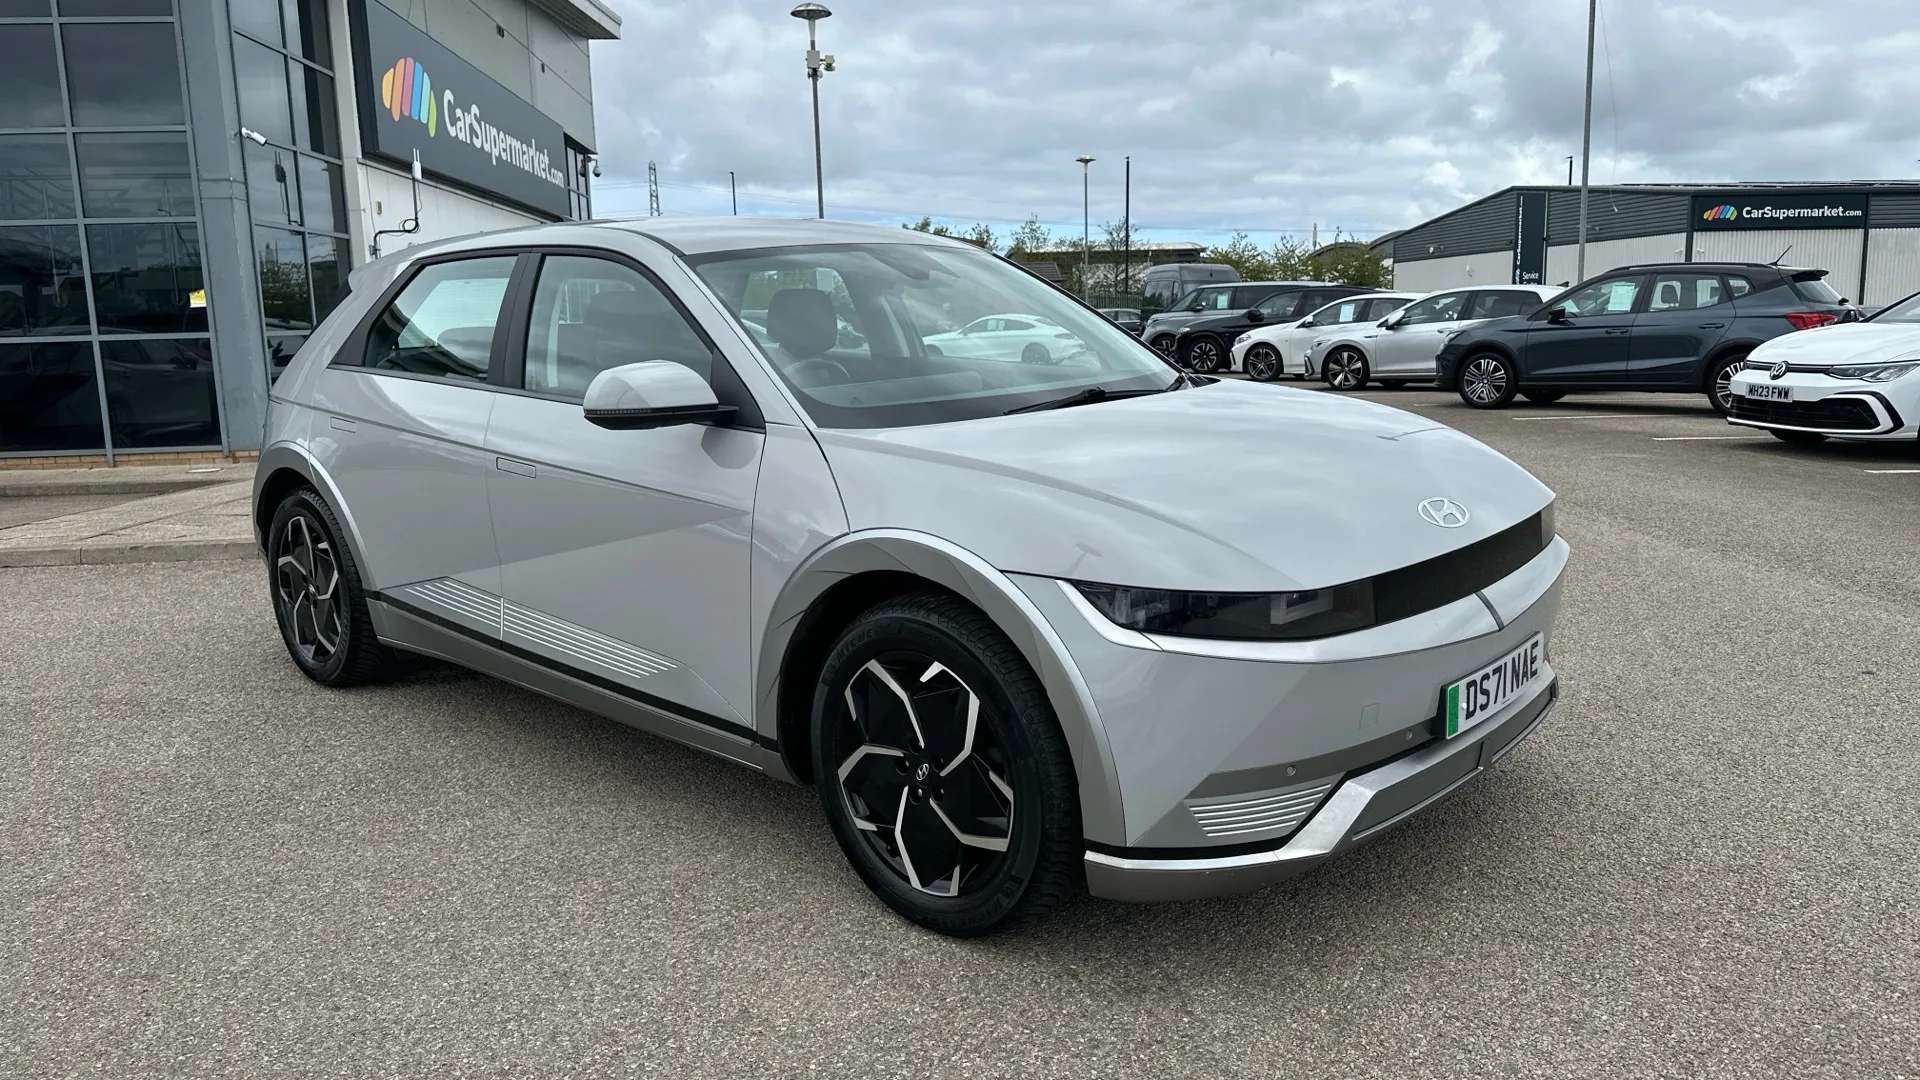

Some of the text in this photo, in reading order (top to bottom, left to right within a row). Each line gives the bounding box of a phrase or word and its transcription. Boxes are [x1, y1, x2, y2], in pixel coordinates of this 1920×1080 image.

[443, 89, 565, 188] CarSupermarket.com
[1742, 205, 1862, 220] CarSupermarket.com
[1465, 640, 1539, 720] DS71 NAE
